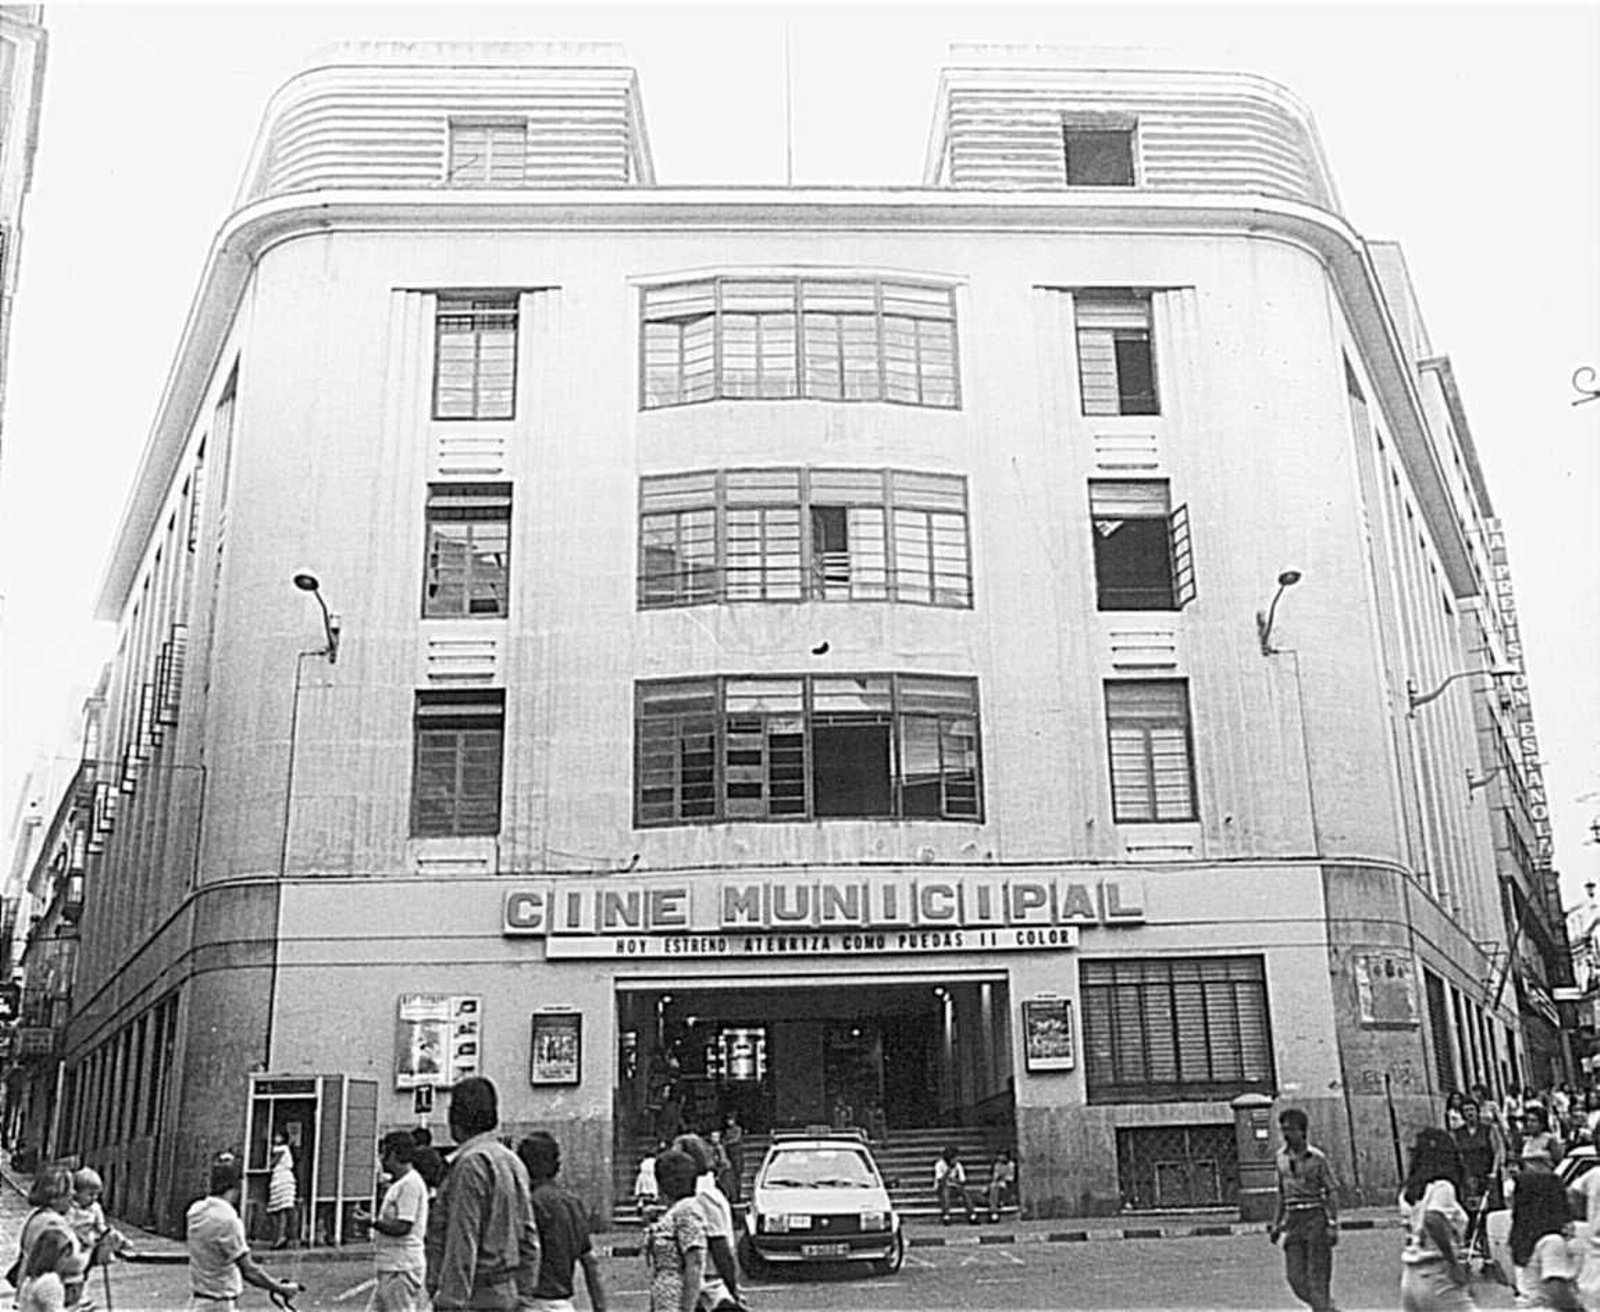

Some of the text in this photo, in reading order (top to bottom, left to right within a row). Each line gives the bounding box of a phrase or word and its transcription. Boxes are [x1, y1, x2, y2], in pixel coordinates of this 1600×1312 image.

[506, 883, 1143, 928] CINE MUNICIPAL
[615, 939, 646, 953] HOY
[664, 937, 727, 953] ESTRENO
[842, 934, 885, 949] COMO
[898, 932, 964, 949] PUEDAS
[980, 932, 997, 946] II
[1015, 930, 1069, 945] COLOR
